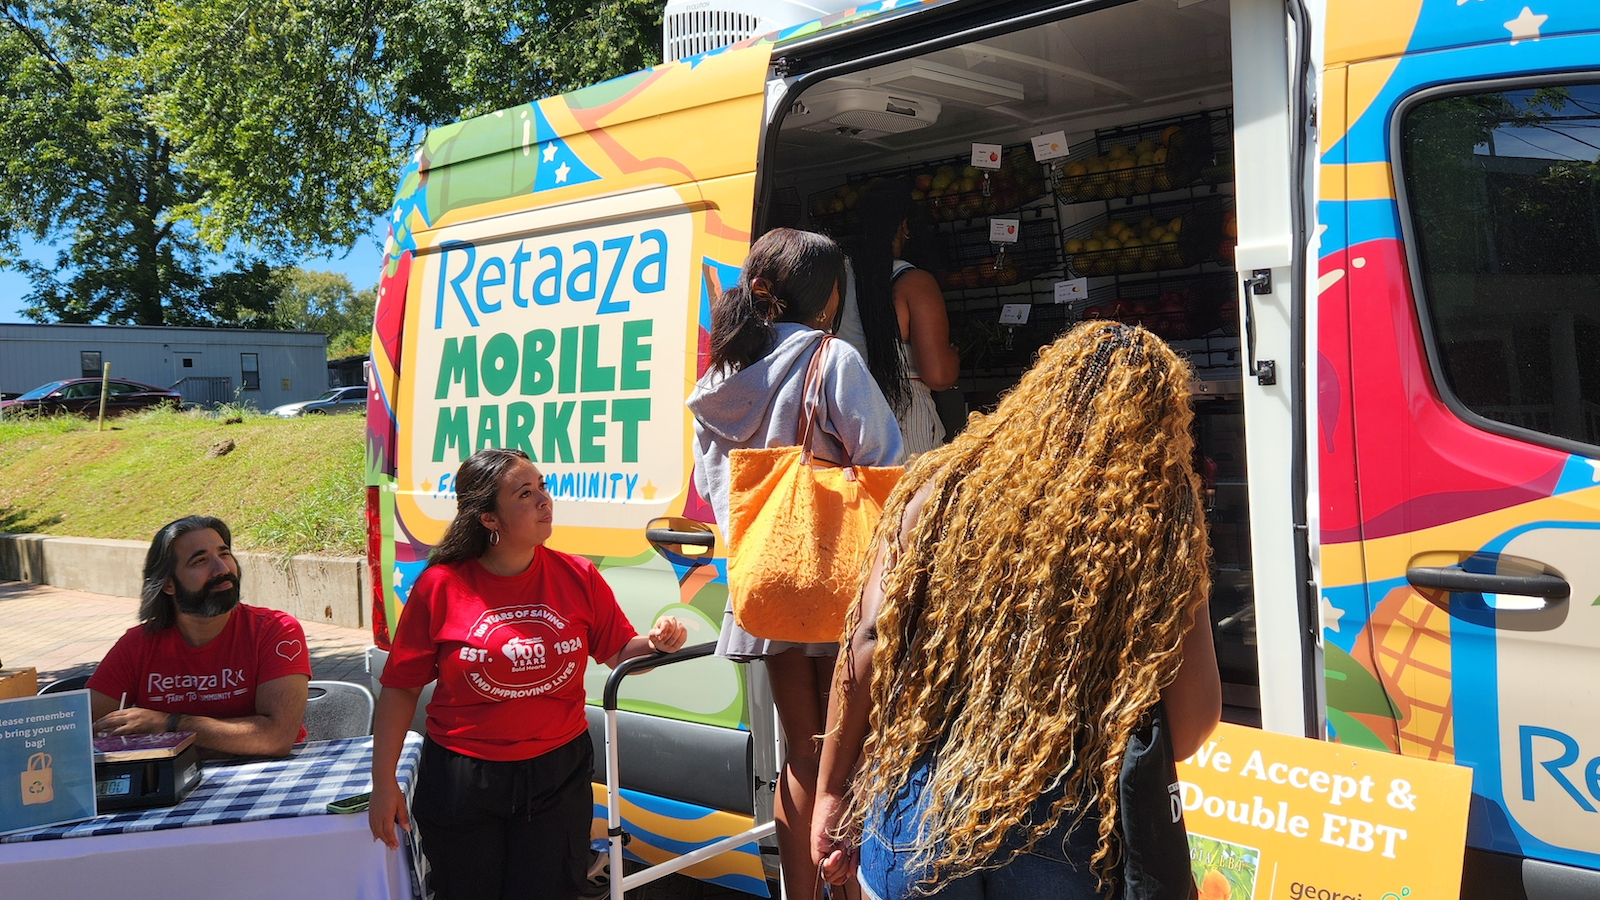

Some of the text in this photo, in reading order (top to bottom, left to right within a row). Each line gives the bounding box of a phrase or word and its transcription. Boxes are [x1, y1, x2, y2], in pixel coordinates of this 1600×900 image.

[434, 229, 668, 330] Retaaza
[434, 319, 653, 400] MOBILE
[432, 397, 651, 463] MARKET
[544, 472, 638, 500] MMUNITY
[474, 609, 565, 638] 100 YEARS OF SAVING
[459, 646, 493, 663] EST.
[554, 637, 582, 655] 1924
[512, 657, 546, 667] YEARS
[470, 661, 576, 699] AND IMPROVING LIVES
[200, 691, 231, 702] MMUNITY
[0, 711, 76, 727] lease remember
[5, 729, 31, 738] bring
[32, 726, 55, 737] your
[56, 723, 76, 731] own
[25, 738, 46, 749] bag!
[1184, 741, 1417, 812] We Accept &
[1178, 781, 1310, 838] Double
[1320, 812, 1408, 859] EBT
[1219, 853, 1245, 872] EBT
